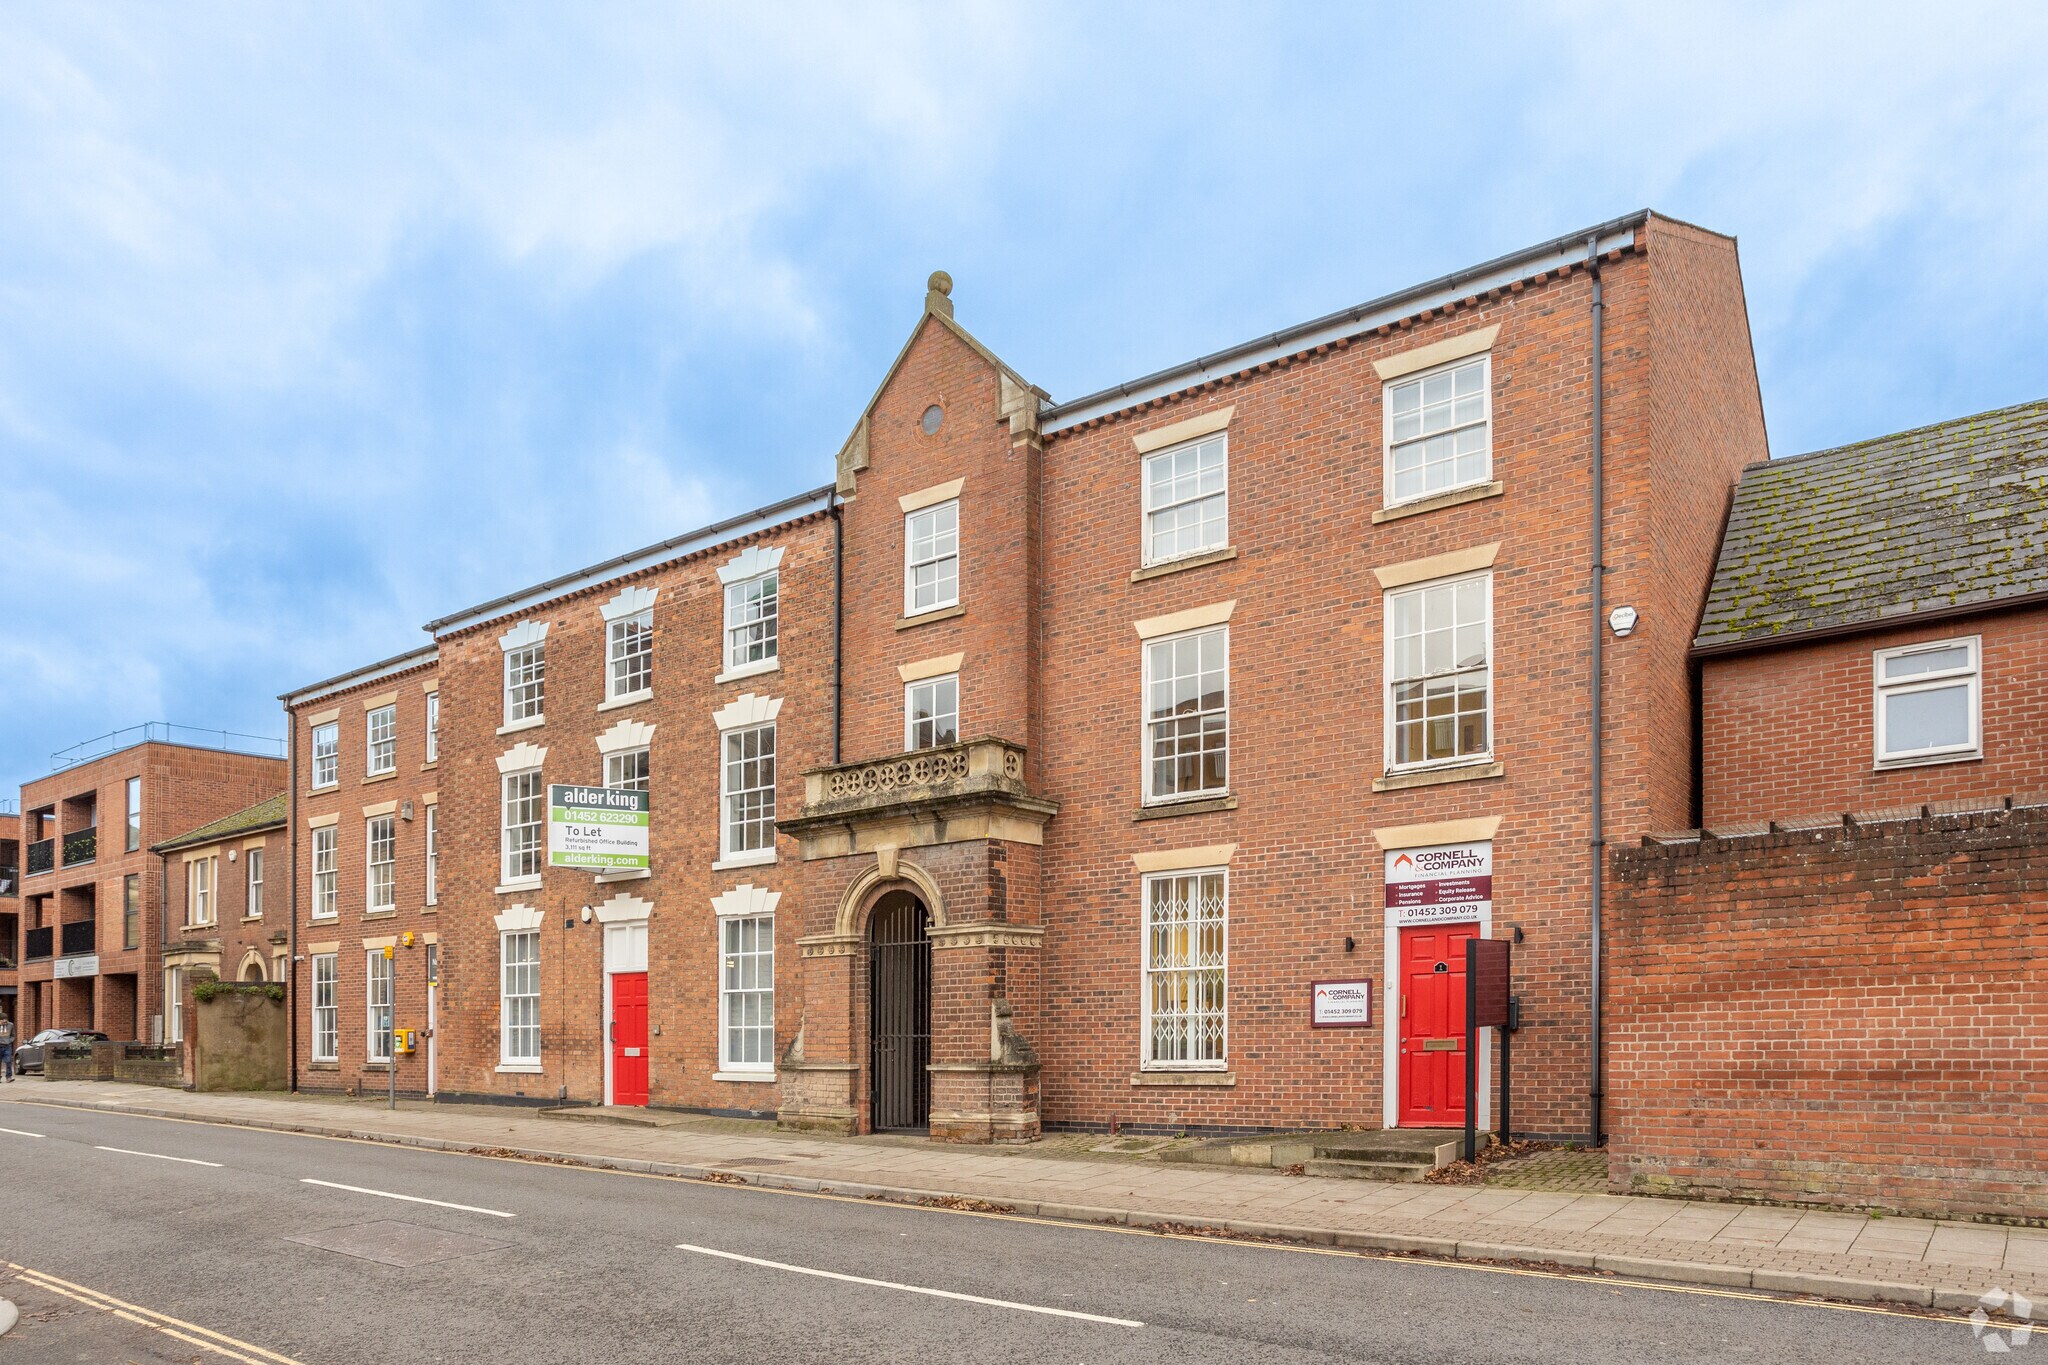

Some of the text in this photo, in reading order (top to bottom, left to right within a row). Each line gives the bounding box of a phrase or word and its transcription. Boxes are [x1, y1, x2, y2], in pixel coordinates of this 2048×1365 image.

[564, 788, 638, 810] alder king
[564, 810, 638, 824] 01452 623290
[565, 825, 602, 837] To Let
[564, 853, 638, 866] alderking.com
[1415, 849, 1477, 862] CORNELL
[1398, 883, 1426, 891] Mortgages
[1398, 904, 1478, 917] T: 01452 309 079
